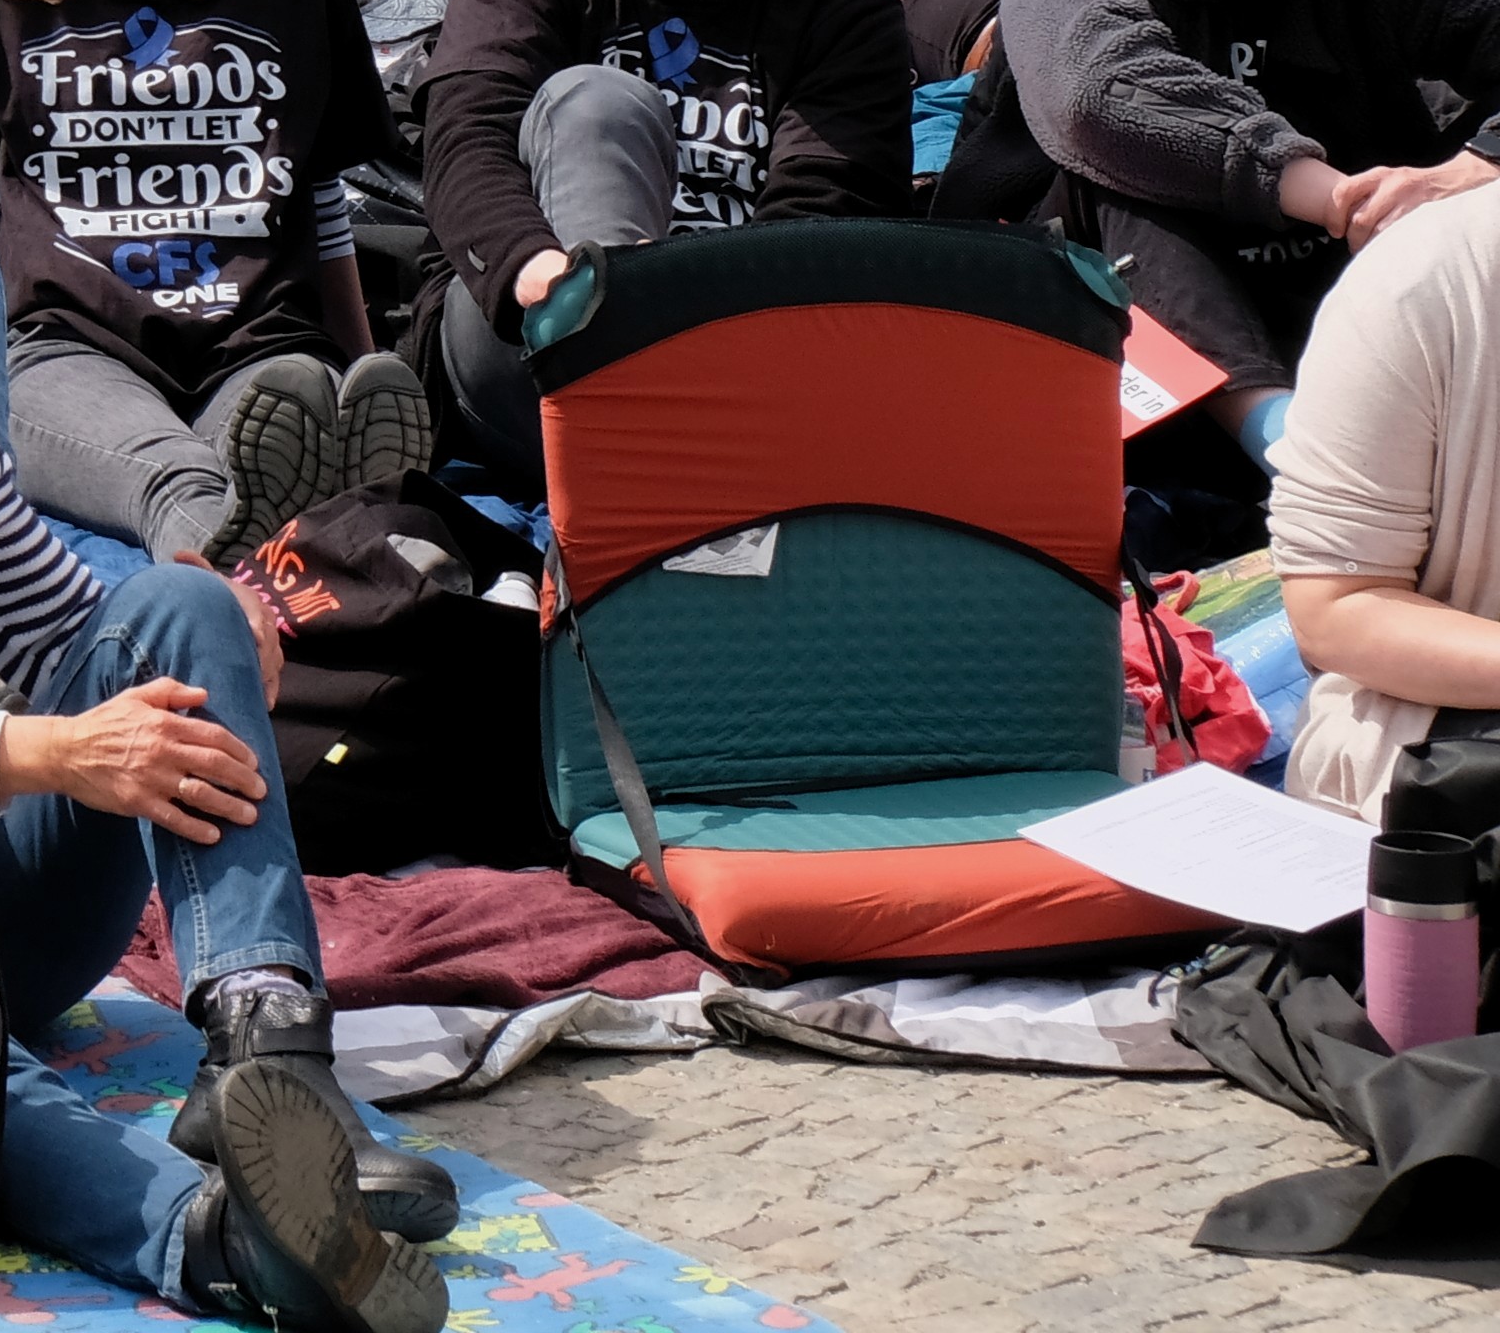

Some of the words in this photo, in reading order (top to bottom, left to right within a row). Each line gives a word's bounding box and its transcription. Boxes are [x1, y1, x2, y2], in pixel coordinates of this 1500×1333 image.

[21, 42, 287, 109] Friends
[68, 115, 175, 143] DON'T
[185, 115, 243, 141] LET
[23, 144, 294, 209] Friends
[109, 208, 216, 232] FIGHT
[112, 238, 222, 288] CFS
[1141, 394, 1164, 414] in
